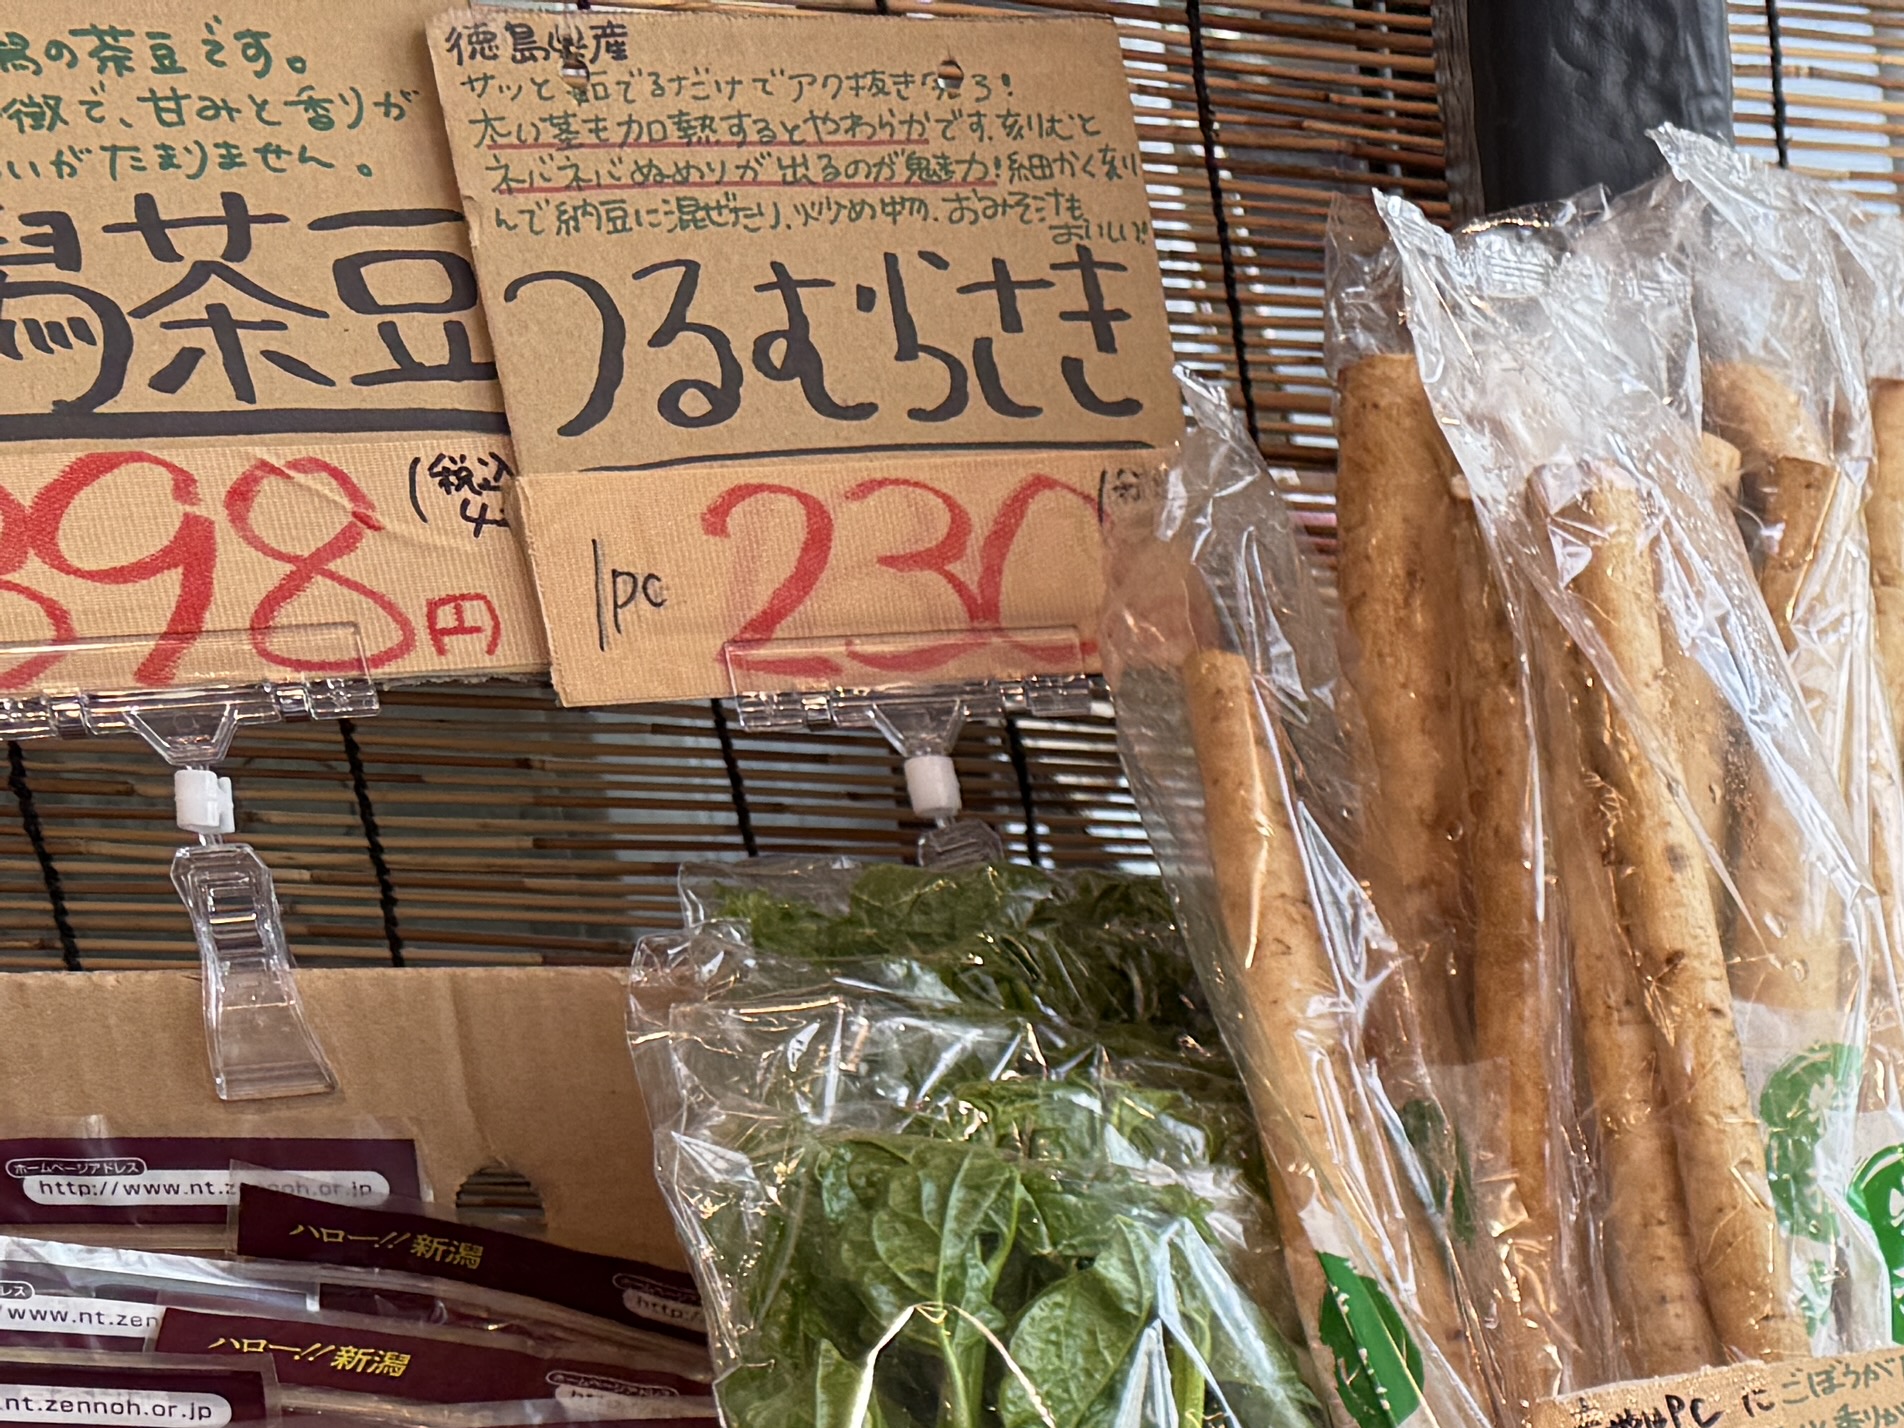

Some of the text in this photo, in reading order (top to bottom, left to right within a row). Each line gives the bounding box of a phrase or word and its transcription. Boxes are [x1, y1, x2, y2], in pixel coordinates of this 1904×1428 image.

[503, 245, 1144, 437] つるむらさき
